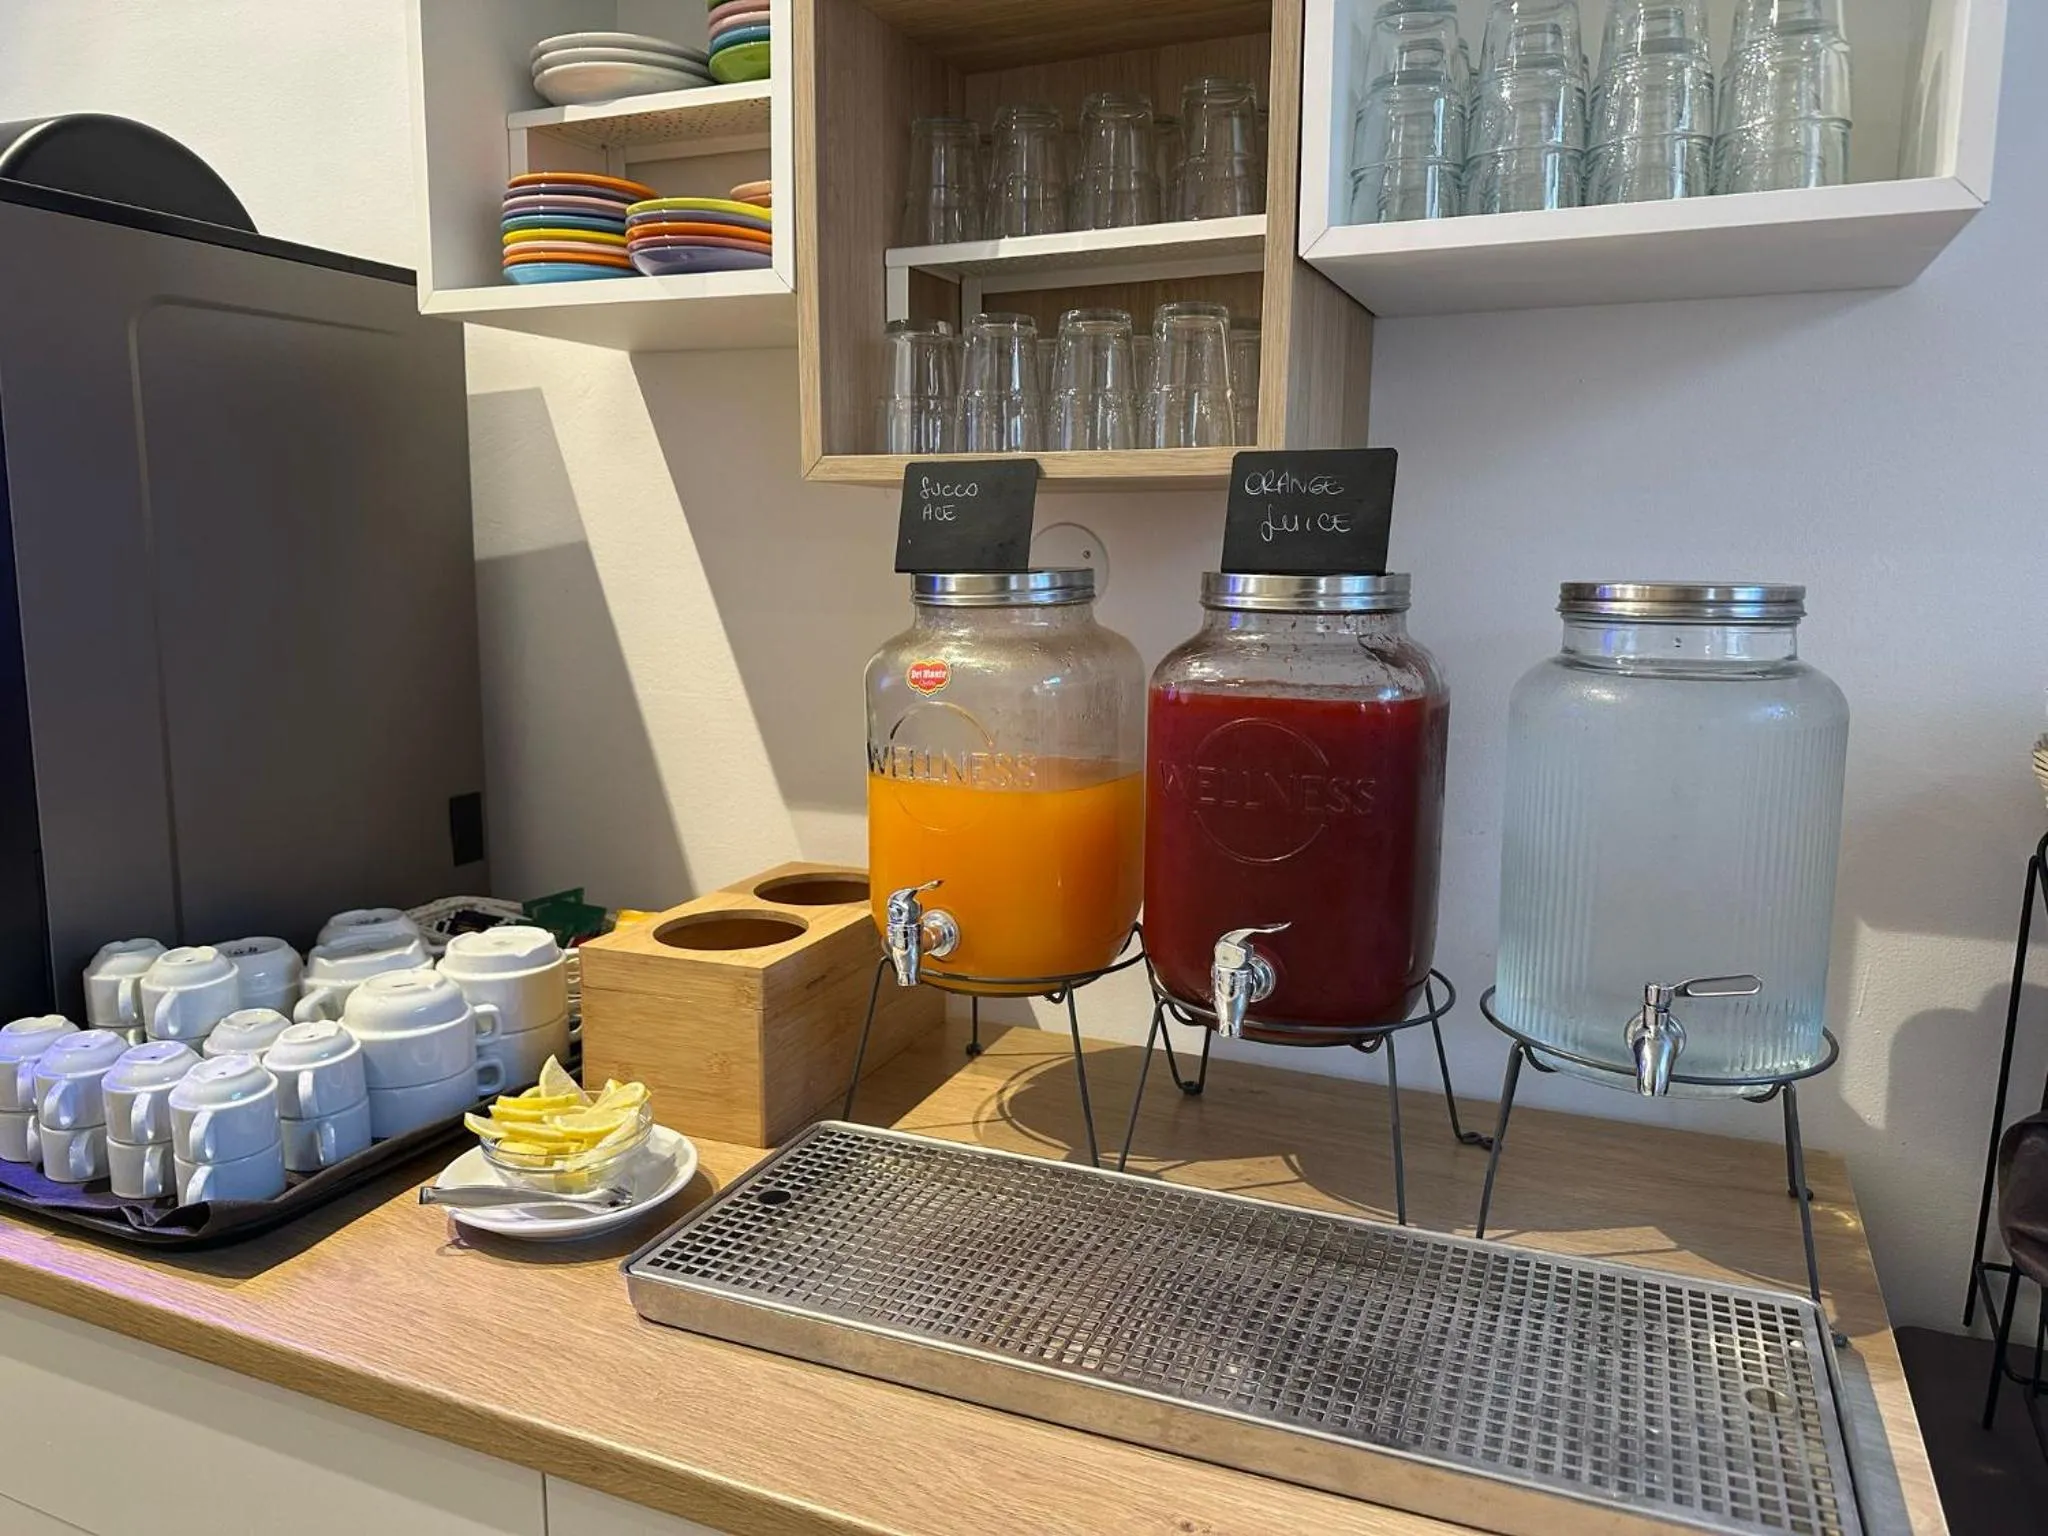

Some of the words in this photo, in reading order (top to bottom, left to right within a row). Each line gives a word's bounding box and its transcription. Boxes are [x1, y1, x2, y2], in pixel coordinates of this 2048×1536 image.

[1244, 469, 1345, 496] ORANGE
[922, 503, 957, 522] ACE
[866, 741, 1037, 787] WELLNESS
[1158, 758, 1376, 815] WELLNESS
